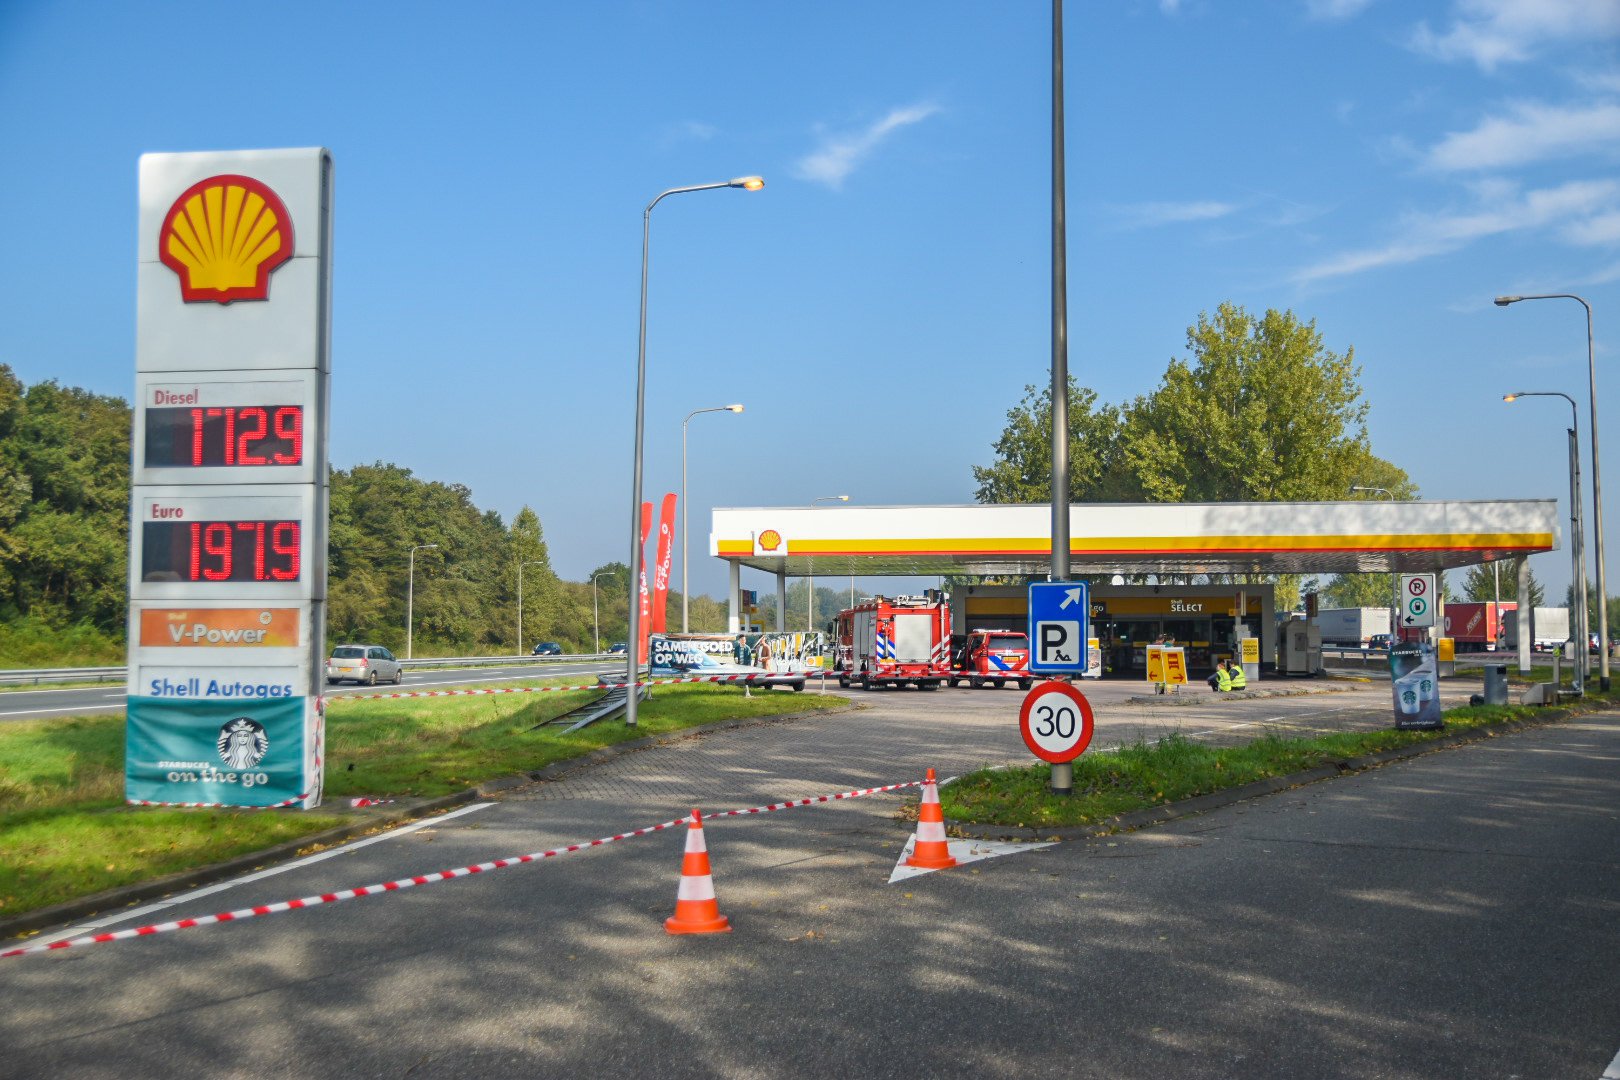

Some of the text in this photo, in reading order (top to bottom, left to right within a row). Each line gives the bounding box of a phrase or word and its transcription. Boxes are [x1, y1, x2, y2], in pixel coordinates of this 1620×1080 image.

[154, 388, 199, 405] Diesel
[191, 407, 304, 466] 172.9
[152, 503, 184, 519] Euro
[190, 521, 300, 581] 197.9
[1170, 604, 1203, 612] SELECT
[168, 623, 267, 643] V-Power
[1041, 624, 1067, 661] P
[655, 653, 704, 664] OP WEG
[151, 678, 293, 699] Shell Autogas
[1036, 705, 1076, 738] 30
[158, 760, 210, 769] STARBUCKS
[167, 767, 269, 787] on the go
